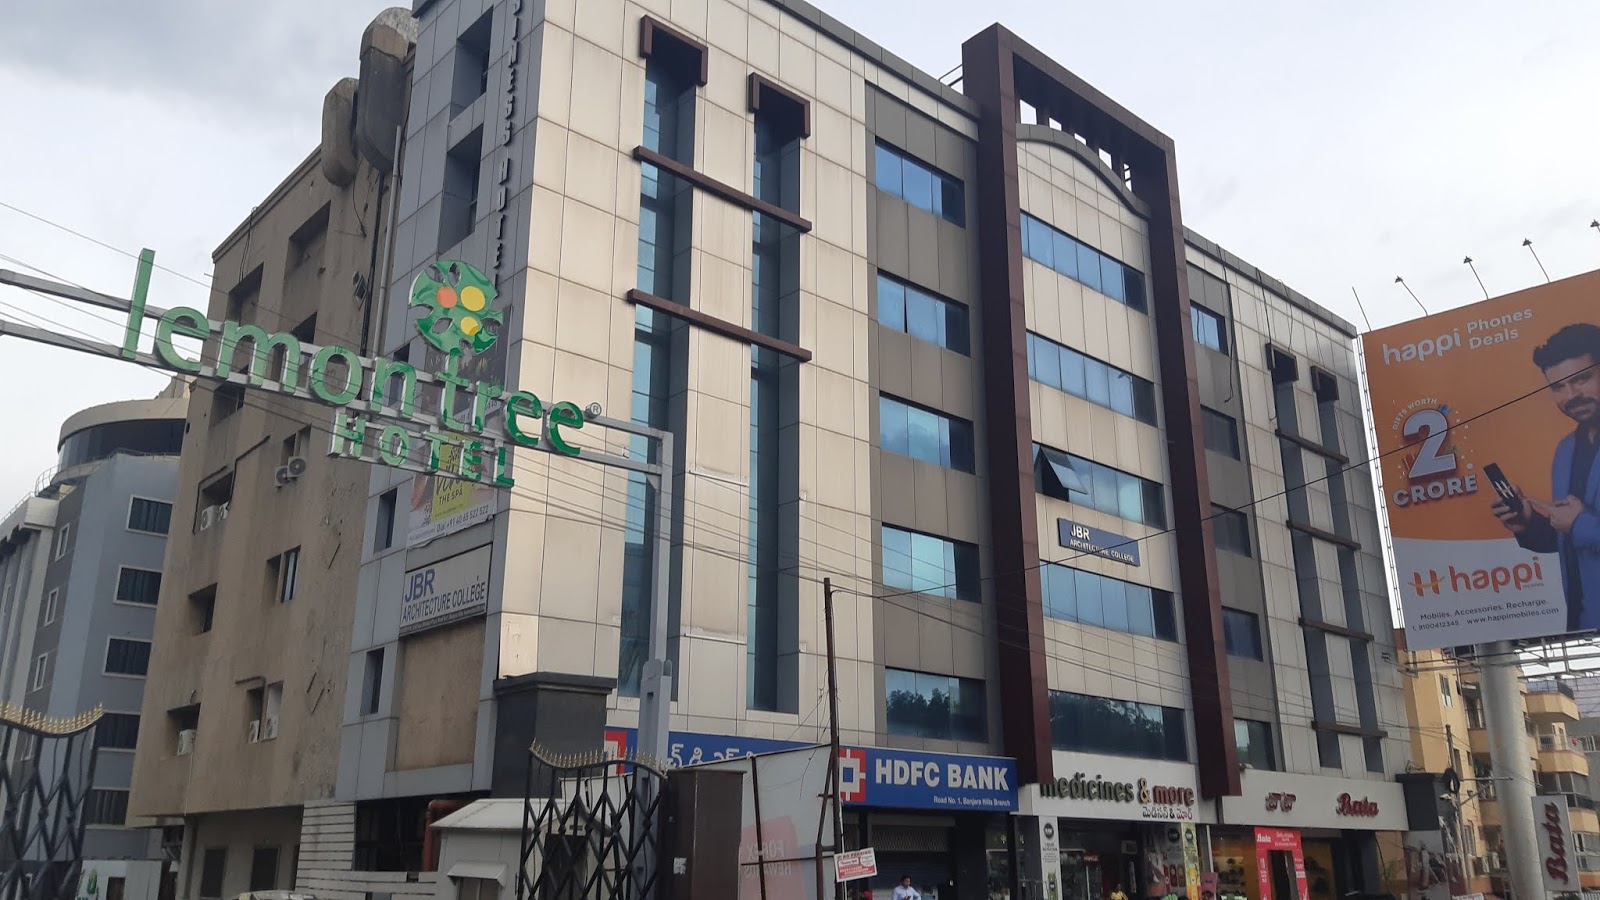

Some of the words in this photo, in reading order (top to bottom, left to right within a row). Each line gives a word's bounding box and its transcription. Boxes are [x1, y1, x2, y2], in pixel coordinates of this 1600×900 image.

[1466, 308, 1533, 334] Phones
[1382, 328, 1462, 365] happi
[1469, 328, 1519, 350] Deals
[1407, 397, 1438, 409] WORTH
[329, 412, 515, 488] HOTEL
[1403, 409, 1456, 478] 2
[439, 494, 450, 505] THE
[451, 488, 463, 500] SPA
[1392, 474, 1478, 506] CRORE
[1069, 524, 1090, 540] JBR
[1110, 550, 1134, 563] COLLEGE
[404, 568, 436, 603] JBR
[1448, 556, 1543, 593] happi
[402, 593, 452, 621] ARCHITECTURE
[452, 582, 486, 608] COLLEGE
[1466, 607, 1560, 625] www.happimobiles.com
[875, 758, 940, 788] HDFC
[947, 763, 1010, 791] BANK
[933, 795, 947, 804] Road
[963, 797, 982, 807] Banjara
[982, 798, 993, 806] Hills
[994, 798, 1011, 807] Branch
[1040, 772, 1135, 802] medicines
[1137, 777, 1152, 804] &
[1153, 784, 1195, 807] more
[1336, 792, 1379, 817] Bata
[1257, 833, 1272, 843] Bata
[1541, 802, 1569, 885] Bata
